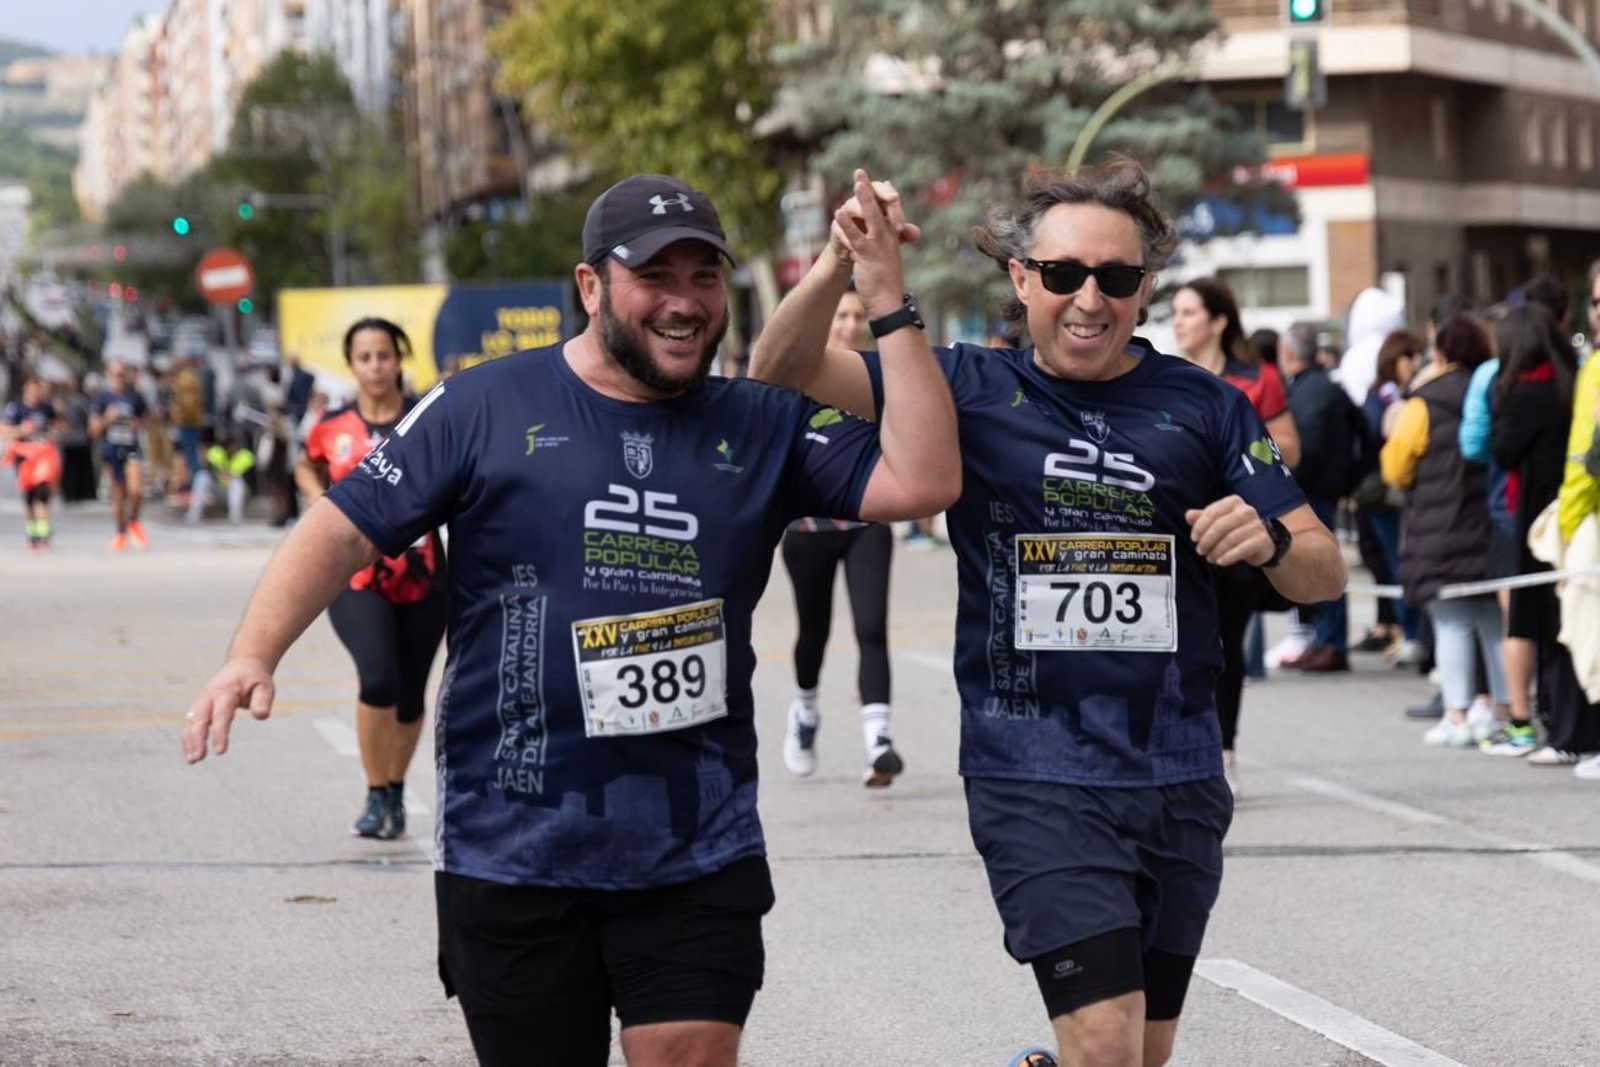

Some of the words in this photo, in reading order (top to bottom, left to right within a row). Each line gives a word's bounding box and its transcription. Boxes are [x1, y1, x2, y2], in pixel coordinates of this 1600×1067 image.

[1044, 438, 1155, 492] 25
[1043, 477, 1153, 506] CARRERA
[1043, 490, 1154, 519] POPULAR
[584, 483, 698, 541] 25
[583, 531, 698, 559] CARRERA
[1023, 541, 1057, 561] XXV
[1059, 541, 1114, 550] CARRERA
[1116, 541, 1167, 552] POPULAR
[1074, 551, 1106, 561] gran
[1113, 551, 1167, 561] caminata
[512, 564, 538, 588] IES
[585, 548, 700, 576] POPULAR
[599, 566, 634, 577] gran
[1050, 581, 1142, 624] 703
[582, 624, 618, 649] XXV
[620, 615, 675, 632] CARRERA
[636, 626, 668, 643] gran
[674, 616, 720, 634] caminata
[505, 594, 520, 694] CATALINA
[616, 654, 706, 709] 389
[501, 700, 520, 761] SANTA
[522, 736, 540, 765] DE
